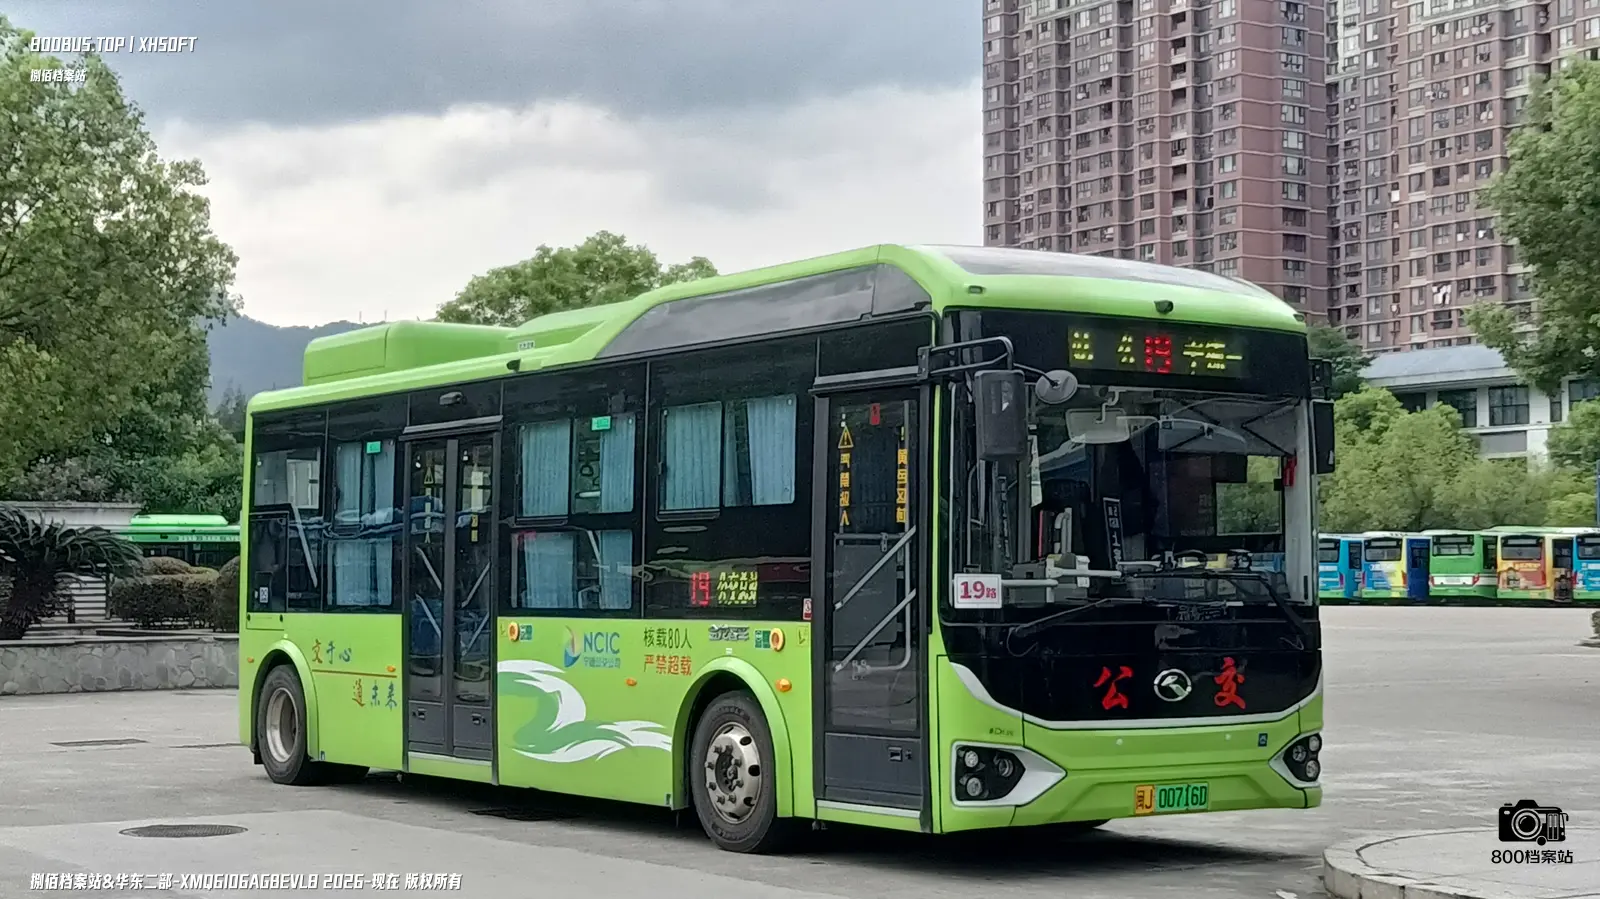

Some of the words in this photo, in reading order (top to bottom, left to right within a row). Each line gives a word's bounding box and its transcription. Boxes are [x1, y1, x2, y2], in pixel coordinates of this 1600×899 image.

[583, 631, 620, 655] NCIC
[643, 627, 692, 649] 核载80人
[643, 653, 692, 675] 严禁超载
[1093, 666, 1133, 709] 公
[1214, 657, 1246, 709] 交
